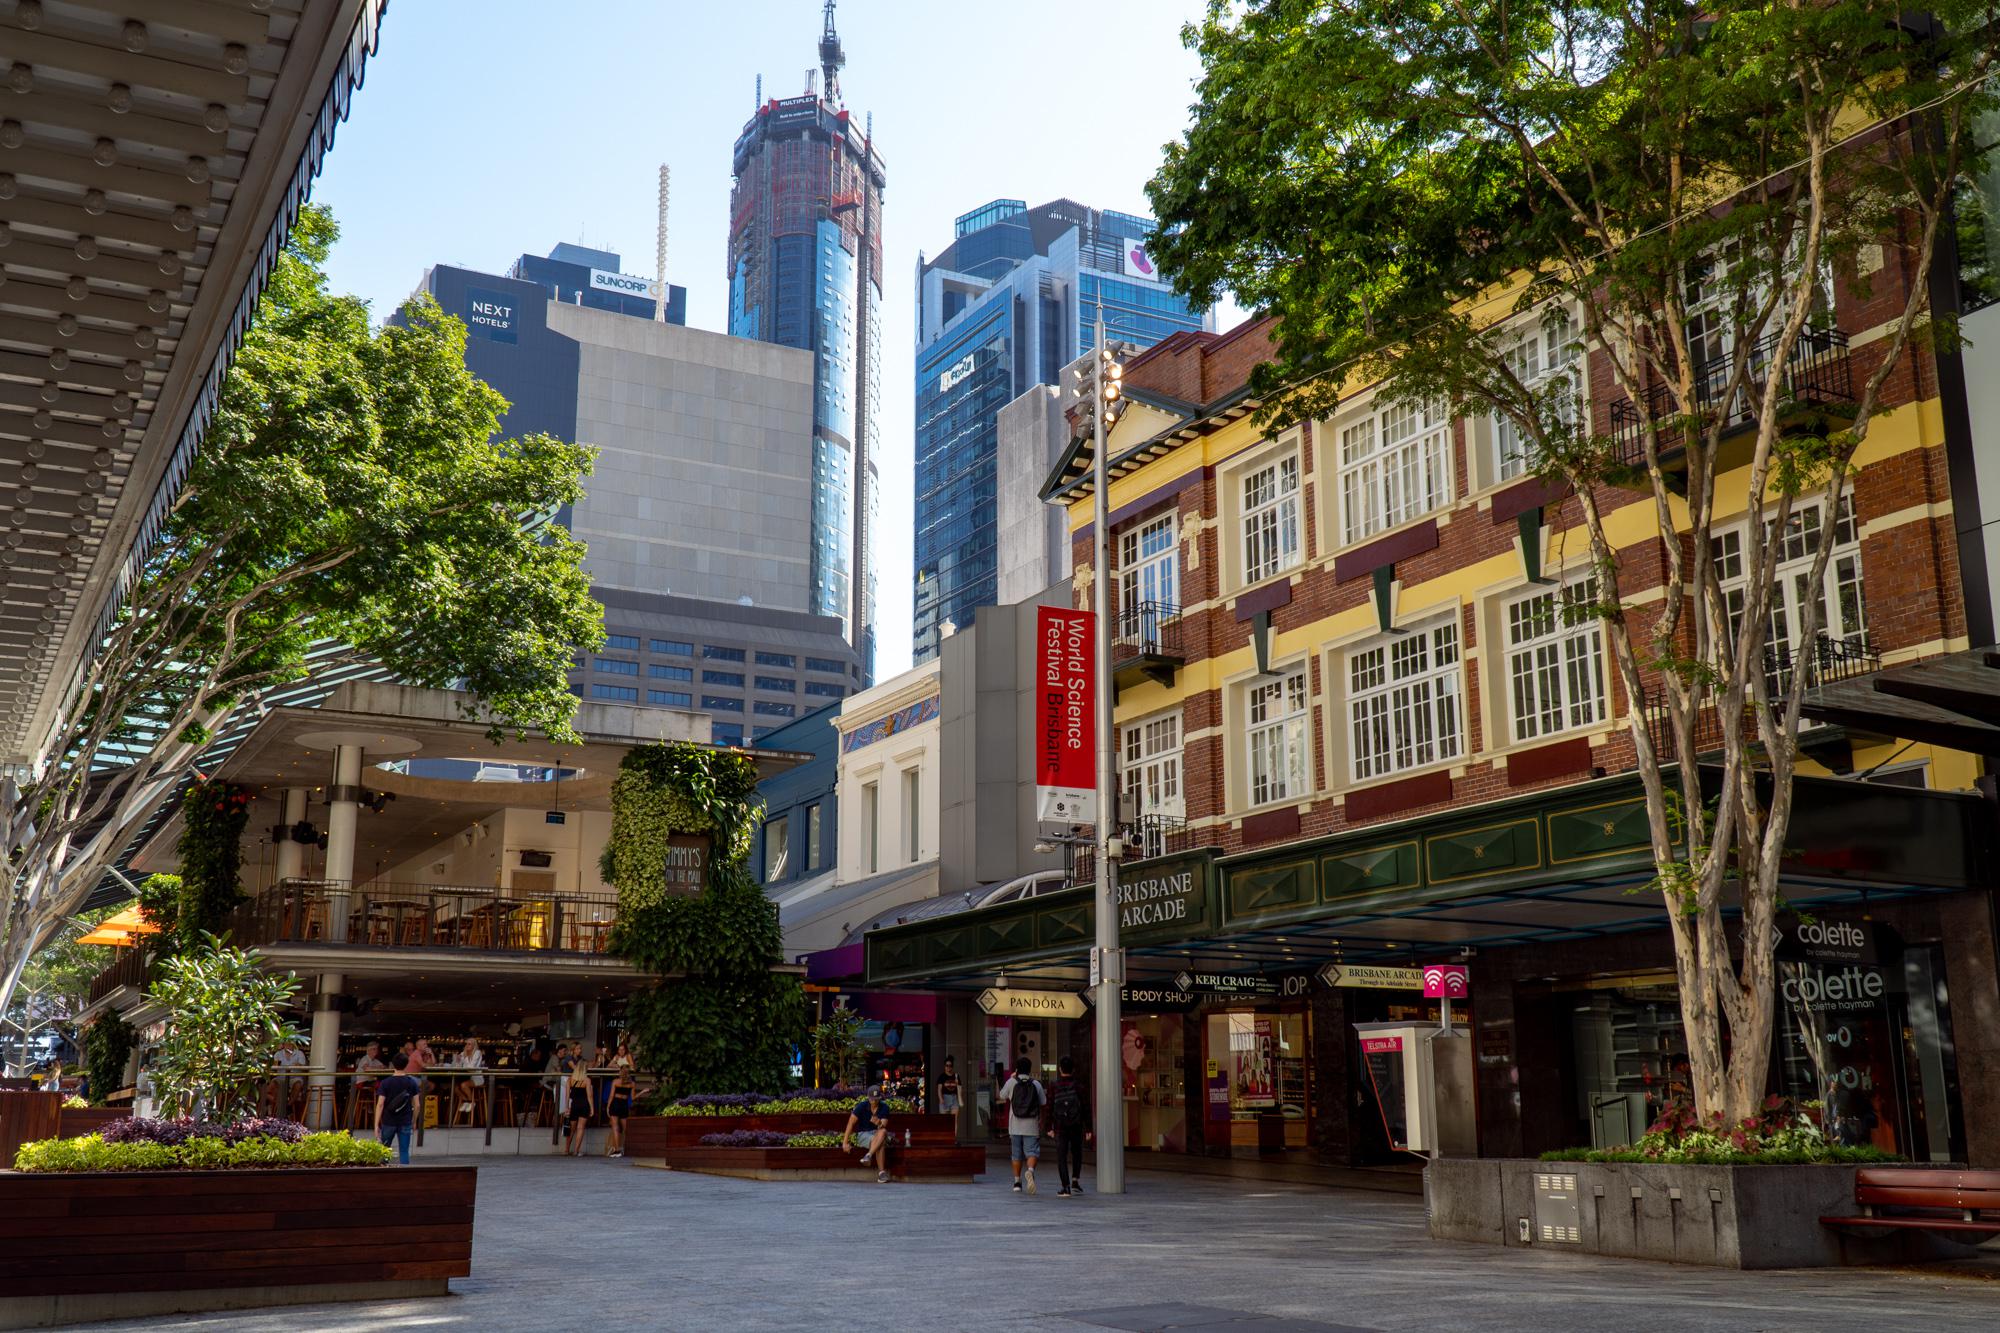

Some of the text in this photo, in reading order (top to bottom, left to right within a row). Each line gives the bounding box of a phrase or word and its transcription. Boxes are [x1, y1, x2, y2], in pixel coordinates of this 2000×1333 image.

[780, 97, 814, 107] MULTIPLEX
[596, 274, 647, 292] SUNCORP
[473, 301, 512, 318] NEXT
[472, 315, 508, 329] HOTELS
[1047, 617, 1064, 687] Festival
[1068, 618, 1085, 749] World Science
[1047, 693, 1064, 773] Brisbane
[1121, 899, 1186, 928] ARCADE
[1798, 920, 1864, 947] colette
[1195, 974, 1221, 986] KERI
[1222, 976, 1255, 988] CRAIG
[1349, 968, 1392, 979] BRISBANE
[1783, 966, 1883, 1003] colette
[1132, 989, 1163, 1002] BODY
[1165, 991, 1194, 1003] SHOP
[1808, 1002, 1837, 1011] colette
[1838, 999, 1874, 1011] hayman
